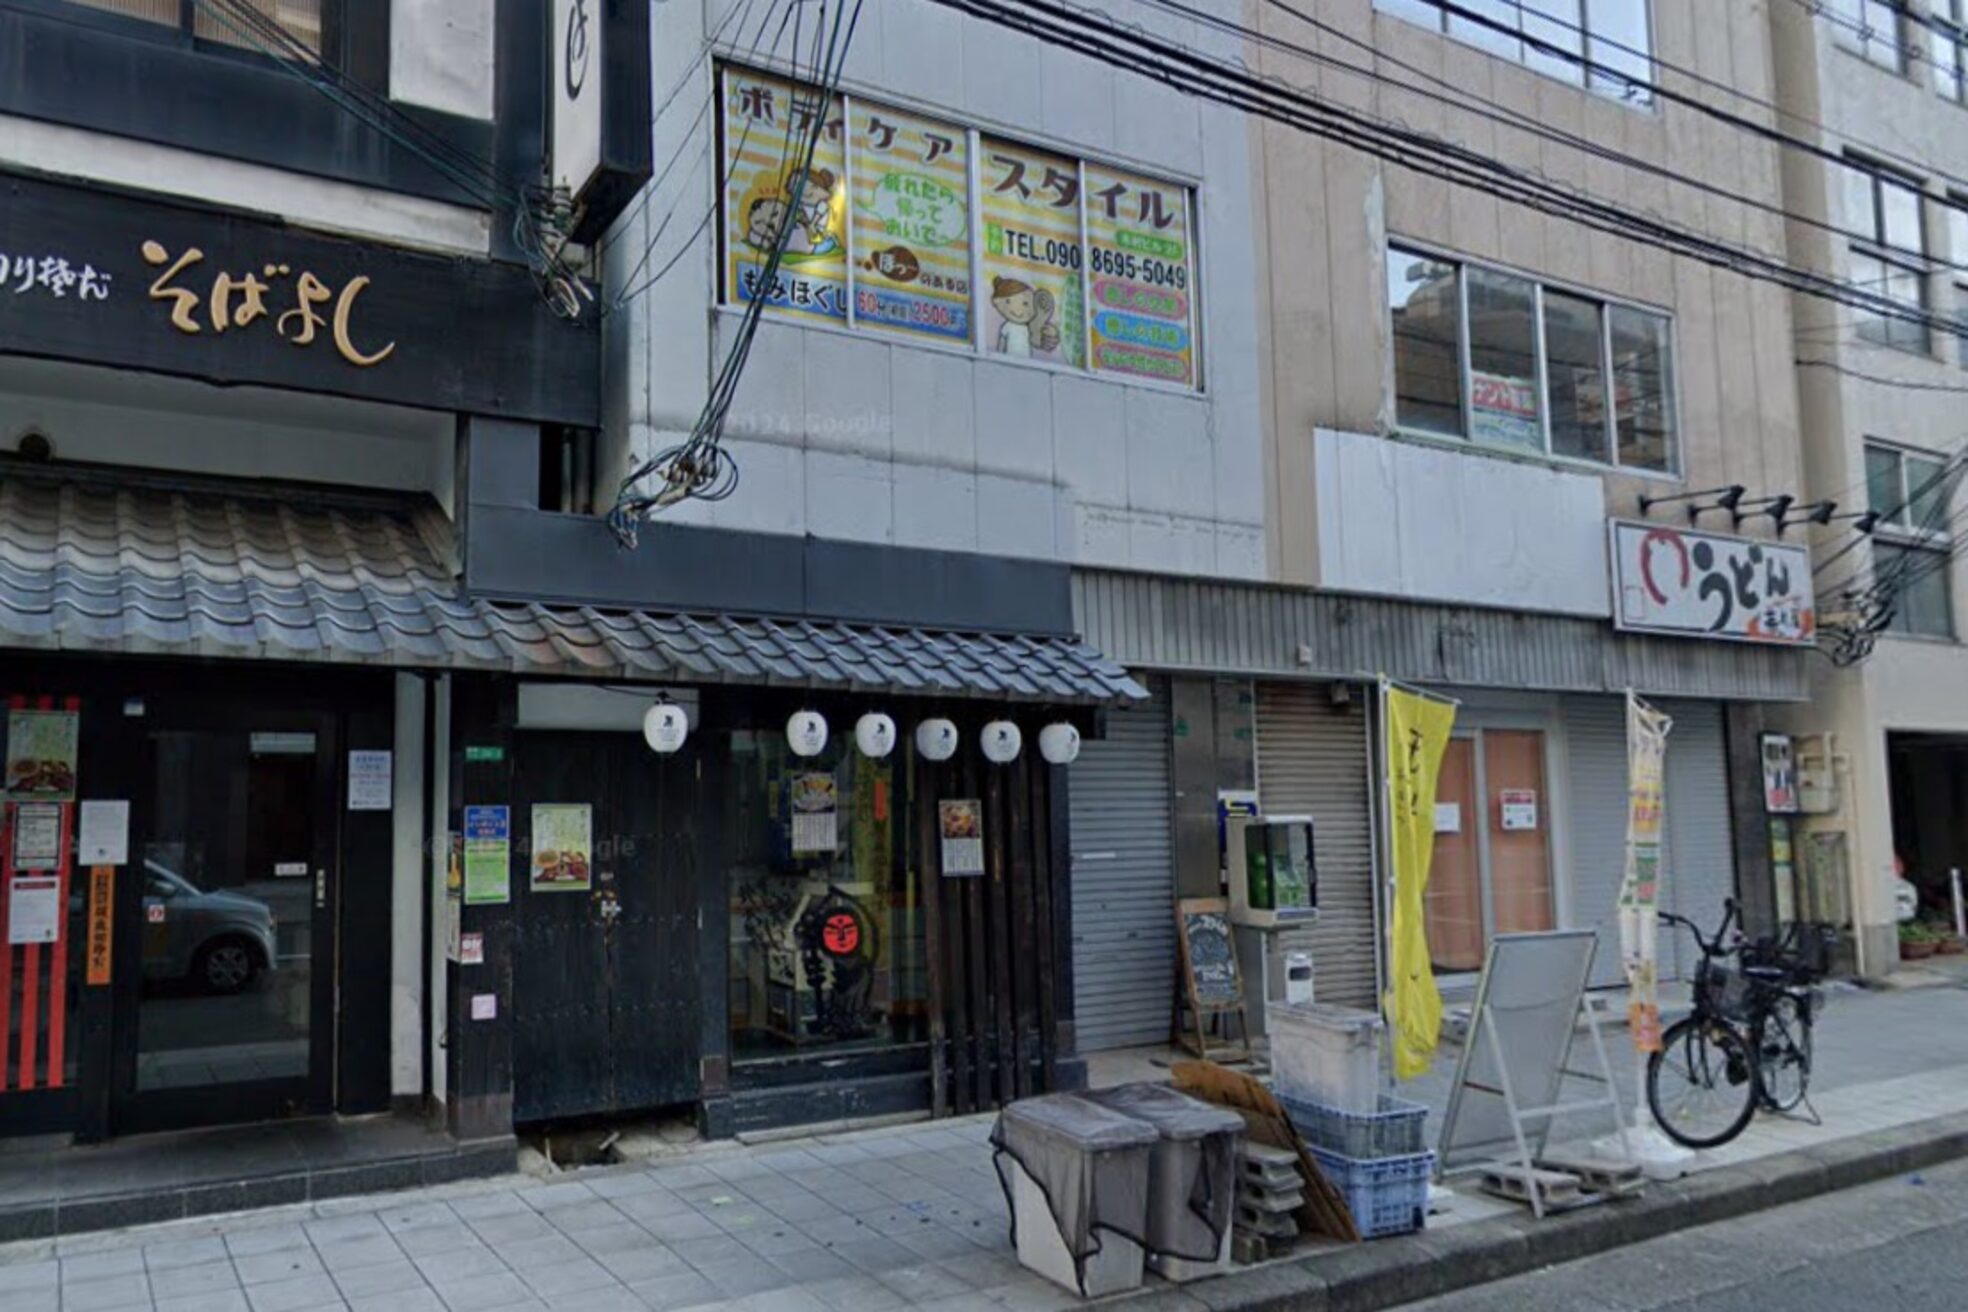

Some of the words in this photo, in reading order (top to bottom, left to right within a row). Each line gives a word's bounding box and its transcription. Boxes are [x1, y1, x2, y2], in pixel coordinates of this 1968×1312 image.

[992, 154, 1175, 229] スタイル
[141, 239, 396, 367] そばよし
[1692, 540, 1790, 632] うどん
